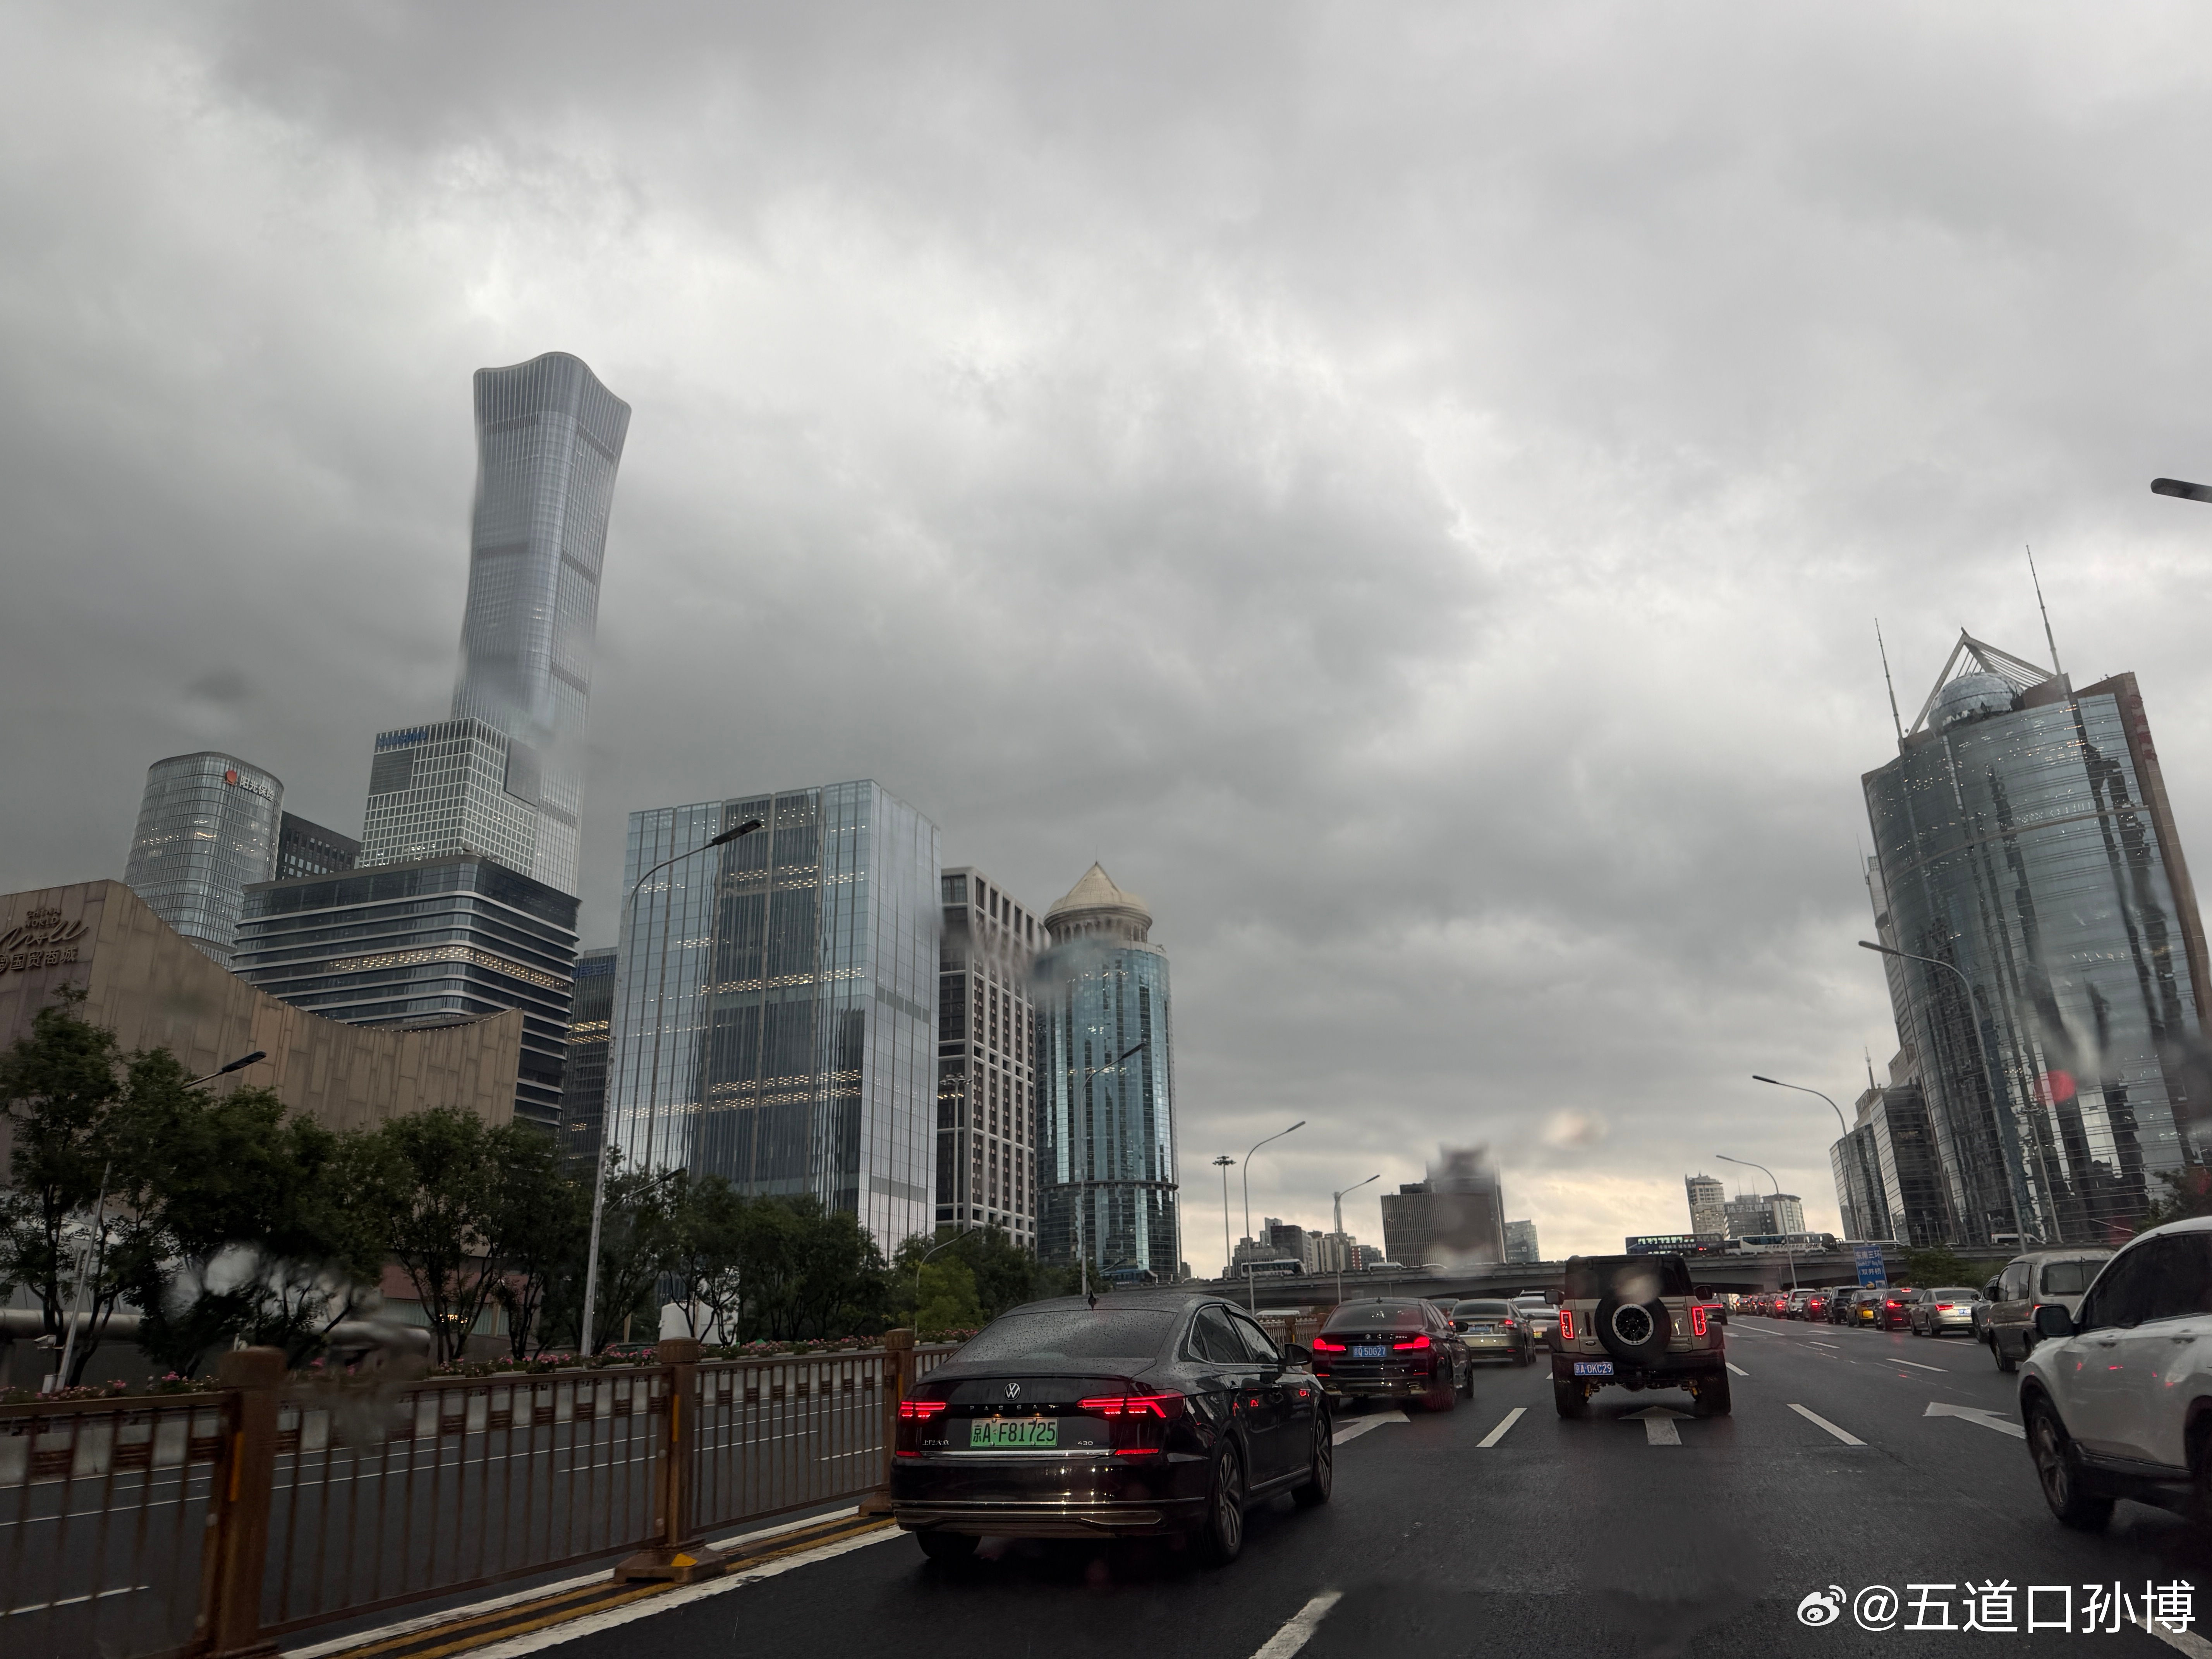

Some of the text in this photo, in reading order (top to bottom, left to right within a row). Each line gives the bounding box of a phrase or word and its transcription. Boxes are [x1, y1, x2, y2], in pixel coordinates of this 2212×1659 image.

[377, 731, 427, 747] SAMSUNG
[239, 775, 274, 802] 阳光保险
[26, 908, 61, 919] CHINA
[25, 917, 60, 928] WORLD
[10, 947, 78, 970] 国贸商城
